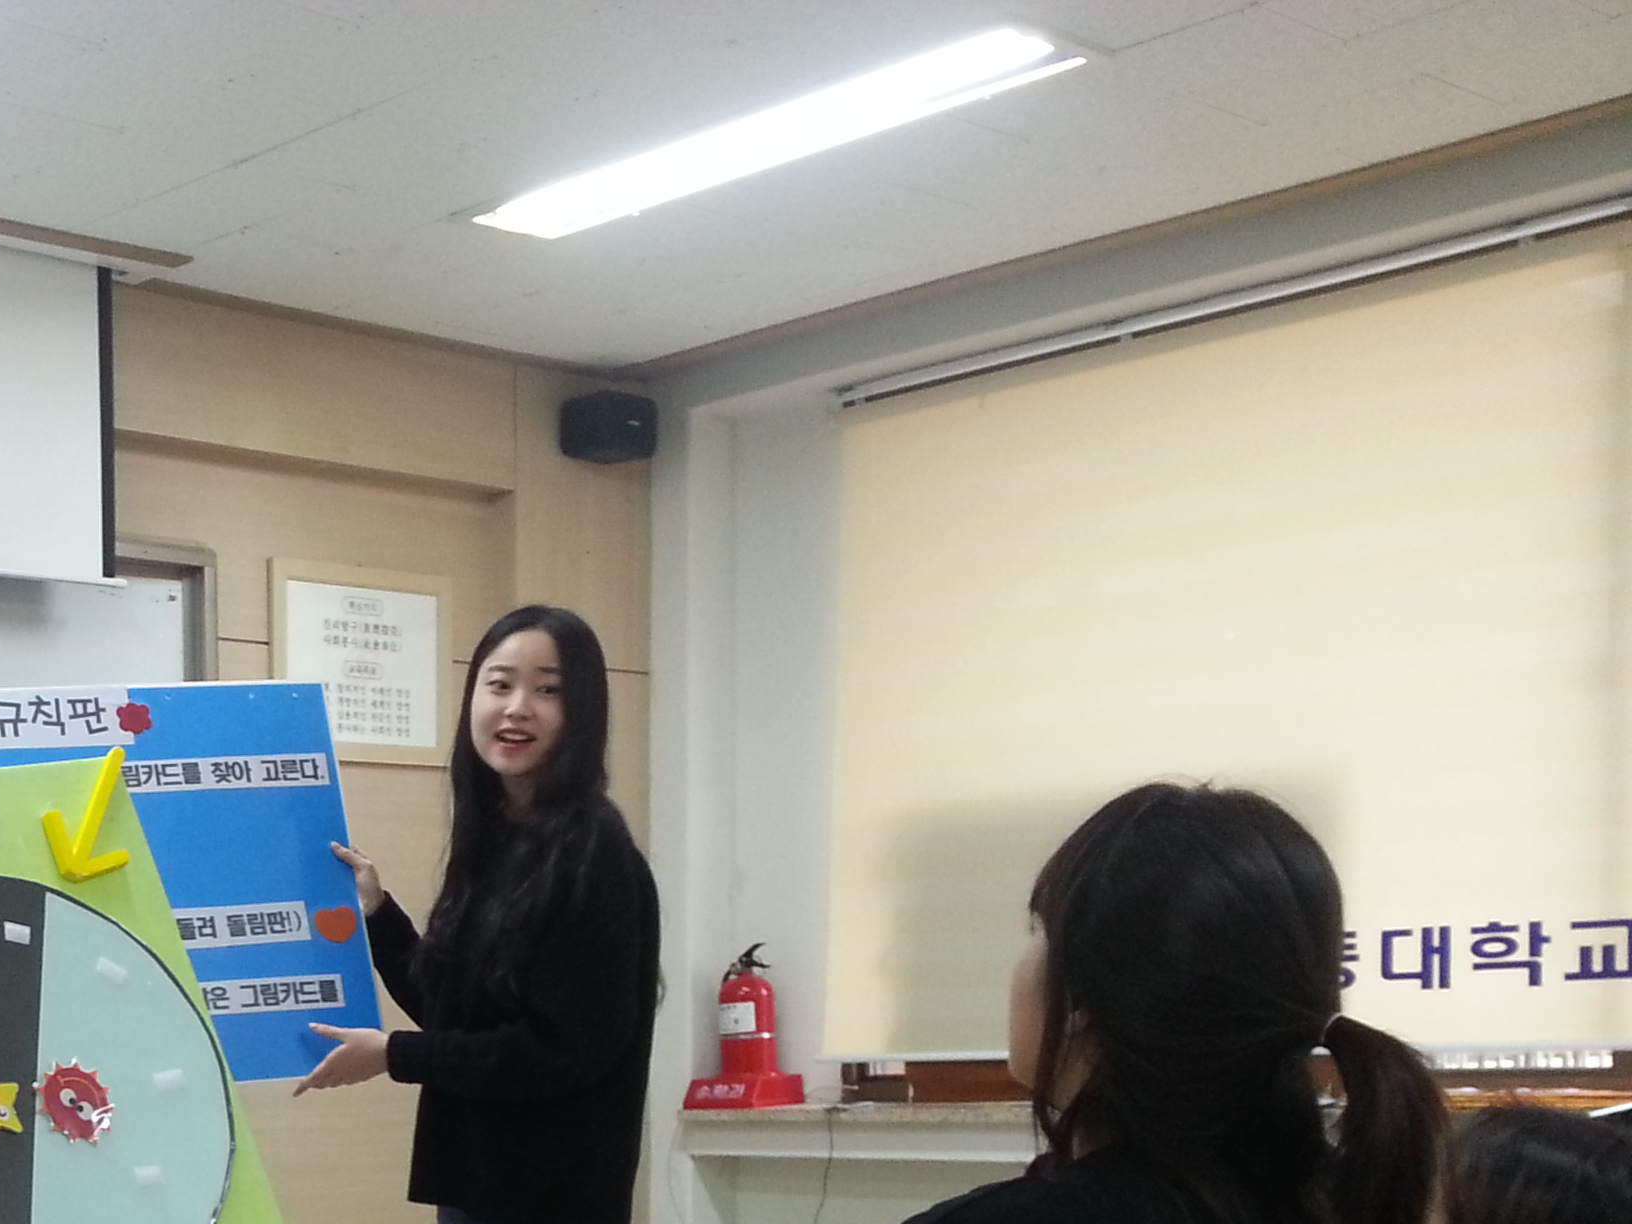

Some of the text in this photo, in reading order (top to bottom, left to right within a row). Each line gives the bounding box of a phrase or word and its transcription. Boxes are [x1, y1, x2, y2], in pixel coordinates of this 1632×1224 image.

[120, 757, 326, 789] 림카드를 찾아 고른다.
[239, 979, 339, 1009] 그림카드를
